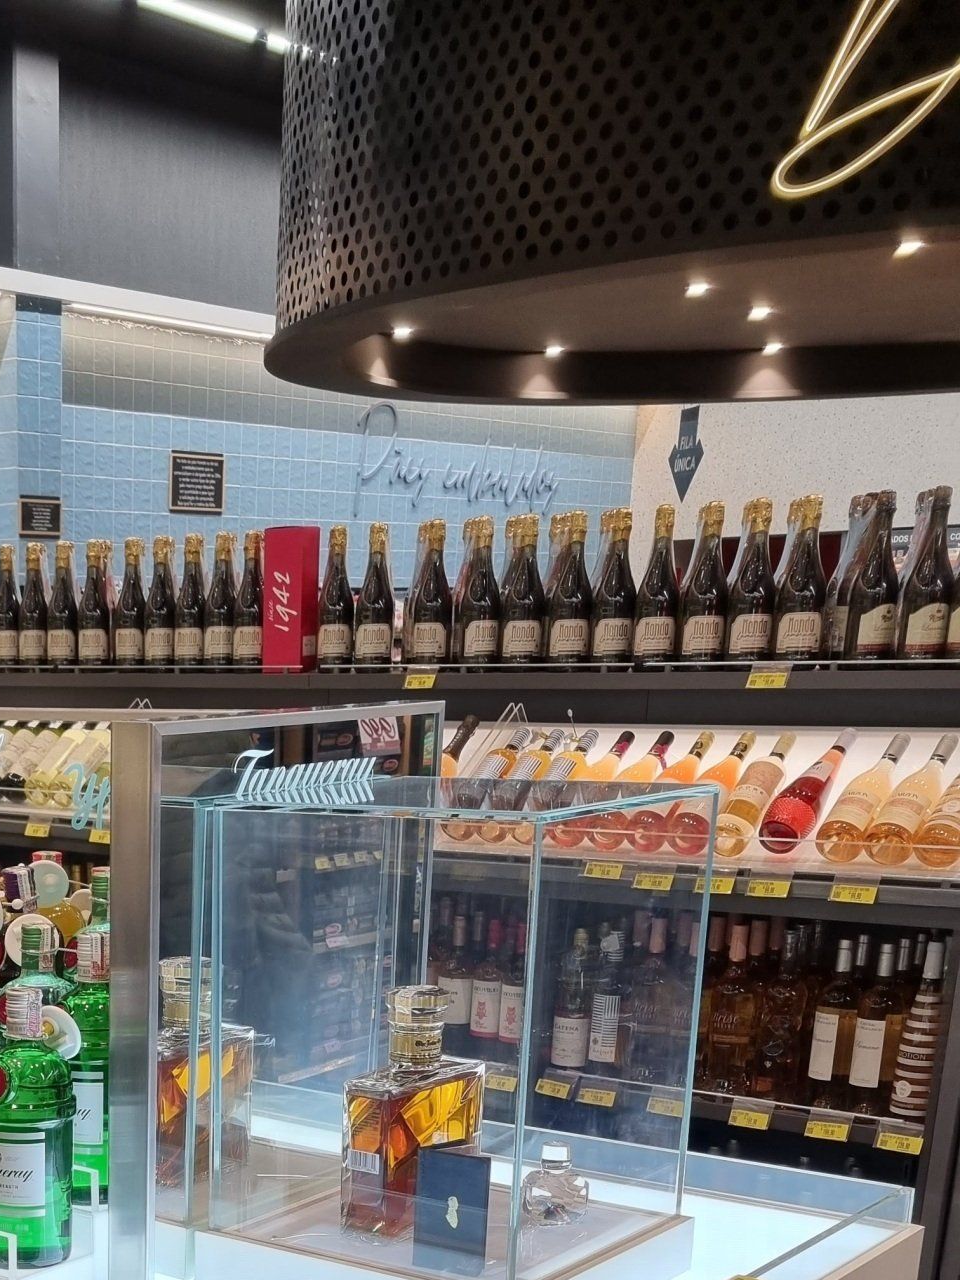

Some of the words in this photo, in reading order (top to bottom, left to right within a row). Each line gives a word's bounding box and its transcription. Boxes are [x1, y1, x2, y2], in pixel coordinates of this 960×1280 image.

[680, 435, 694, 450] FILA
[674, 453, 696, 473] ÚNICA
[273, 571, 298, 633] 1942
